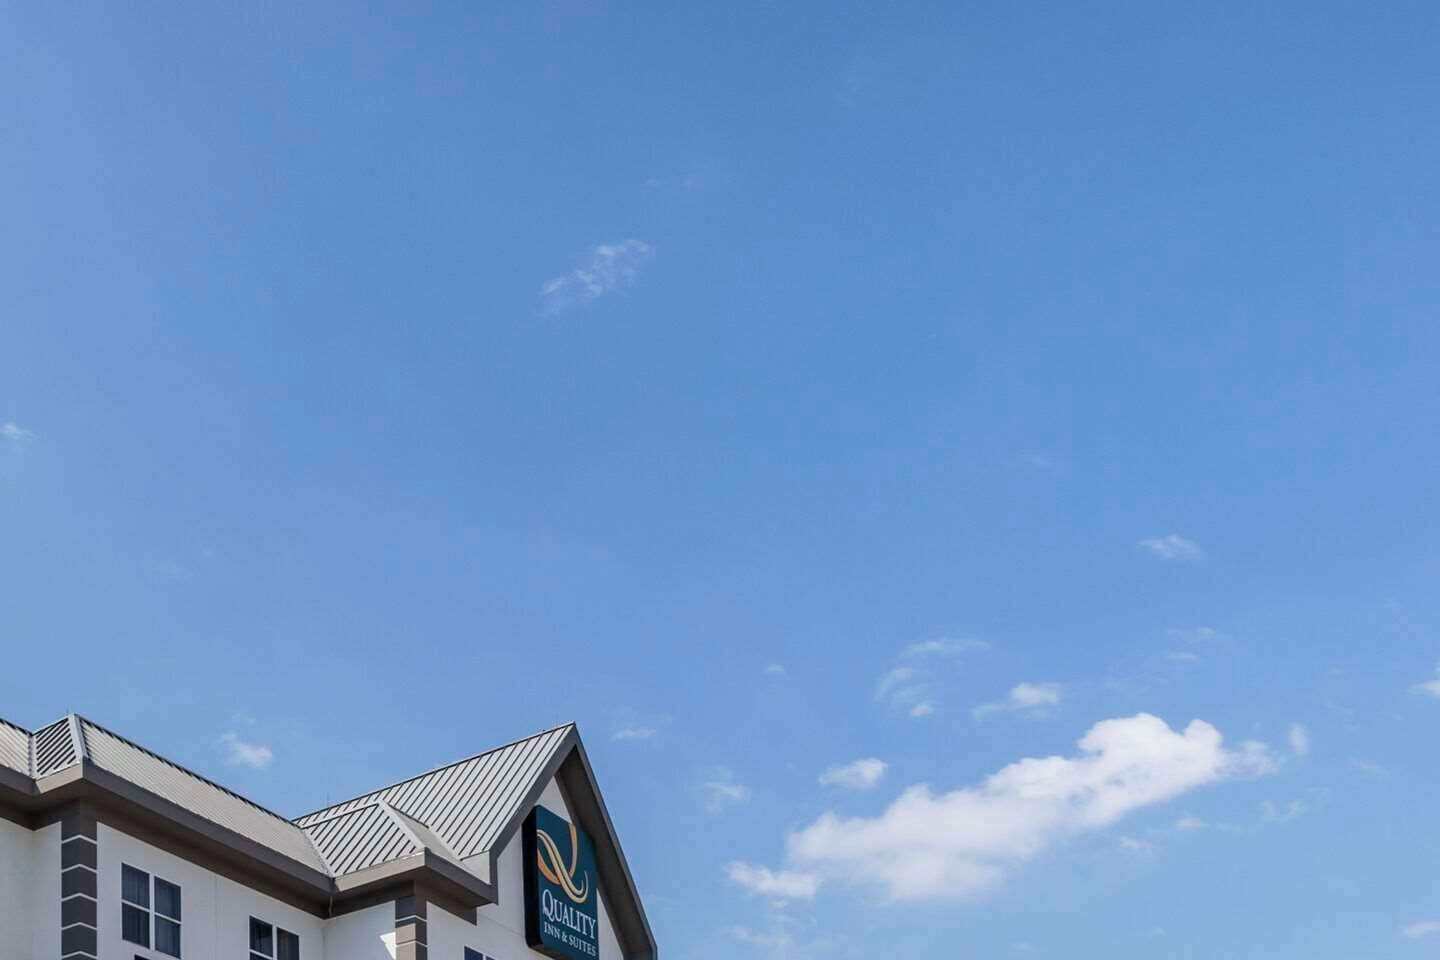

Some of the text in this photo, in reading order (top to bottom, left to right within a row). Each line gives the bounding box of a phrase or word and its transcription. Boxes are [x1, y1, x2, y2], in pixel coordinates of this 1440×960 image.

[542, 888, 596, 939] QUALITY
[544, 921, 596, 957] INN & SUITES
